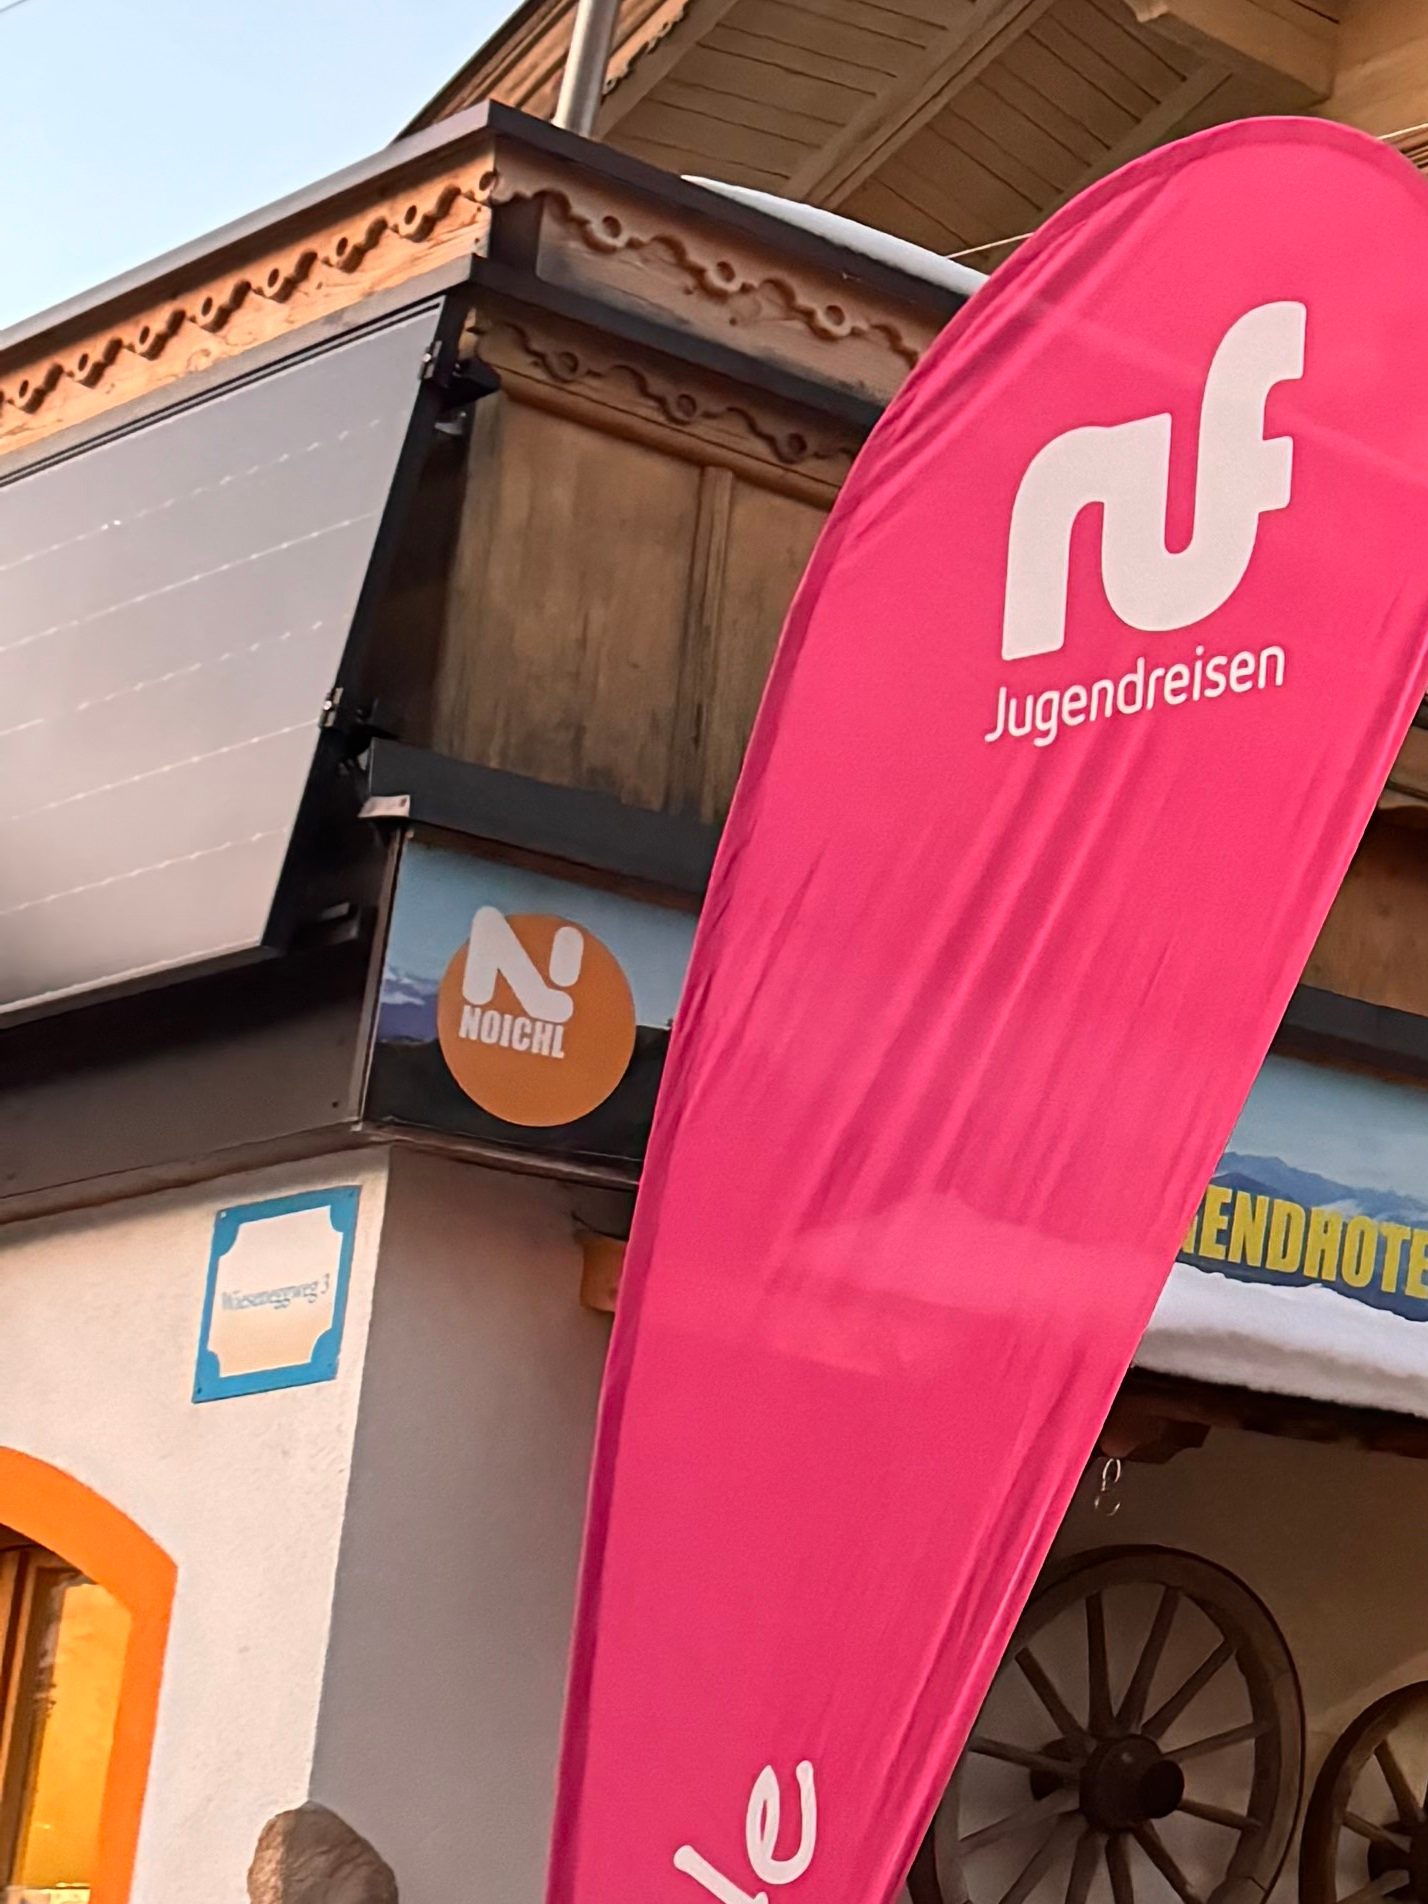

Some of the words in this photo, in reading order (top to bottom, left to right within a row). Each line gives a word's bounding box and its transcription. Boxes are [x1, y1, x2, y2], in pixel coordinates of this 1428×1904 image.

[984, 645, 1286, 747] Jugendreisen
[458, 1004, 566, 1059] NOICHL
[320, 1272, 331, 1295] 3
